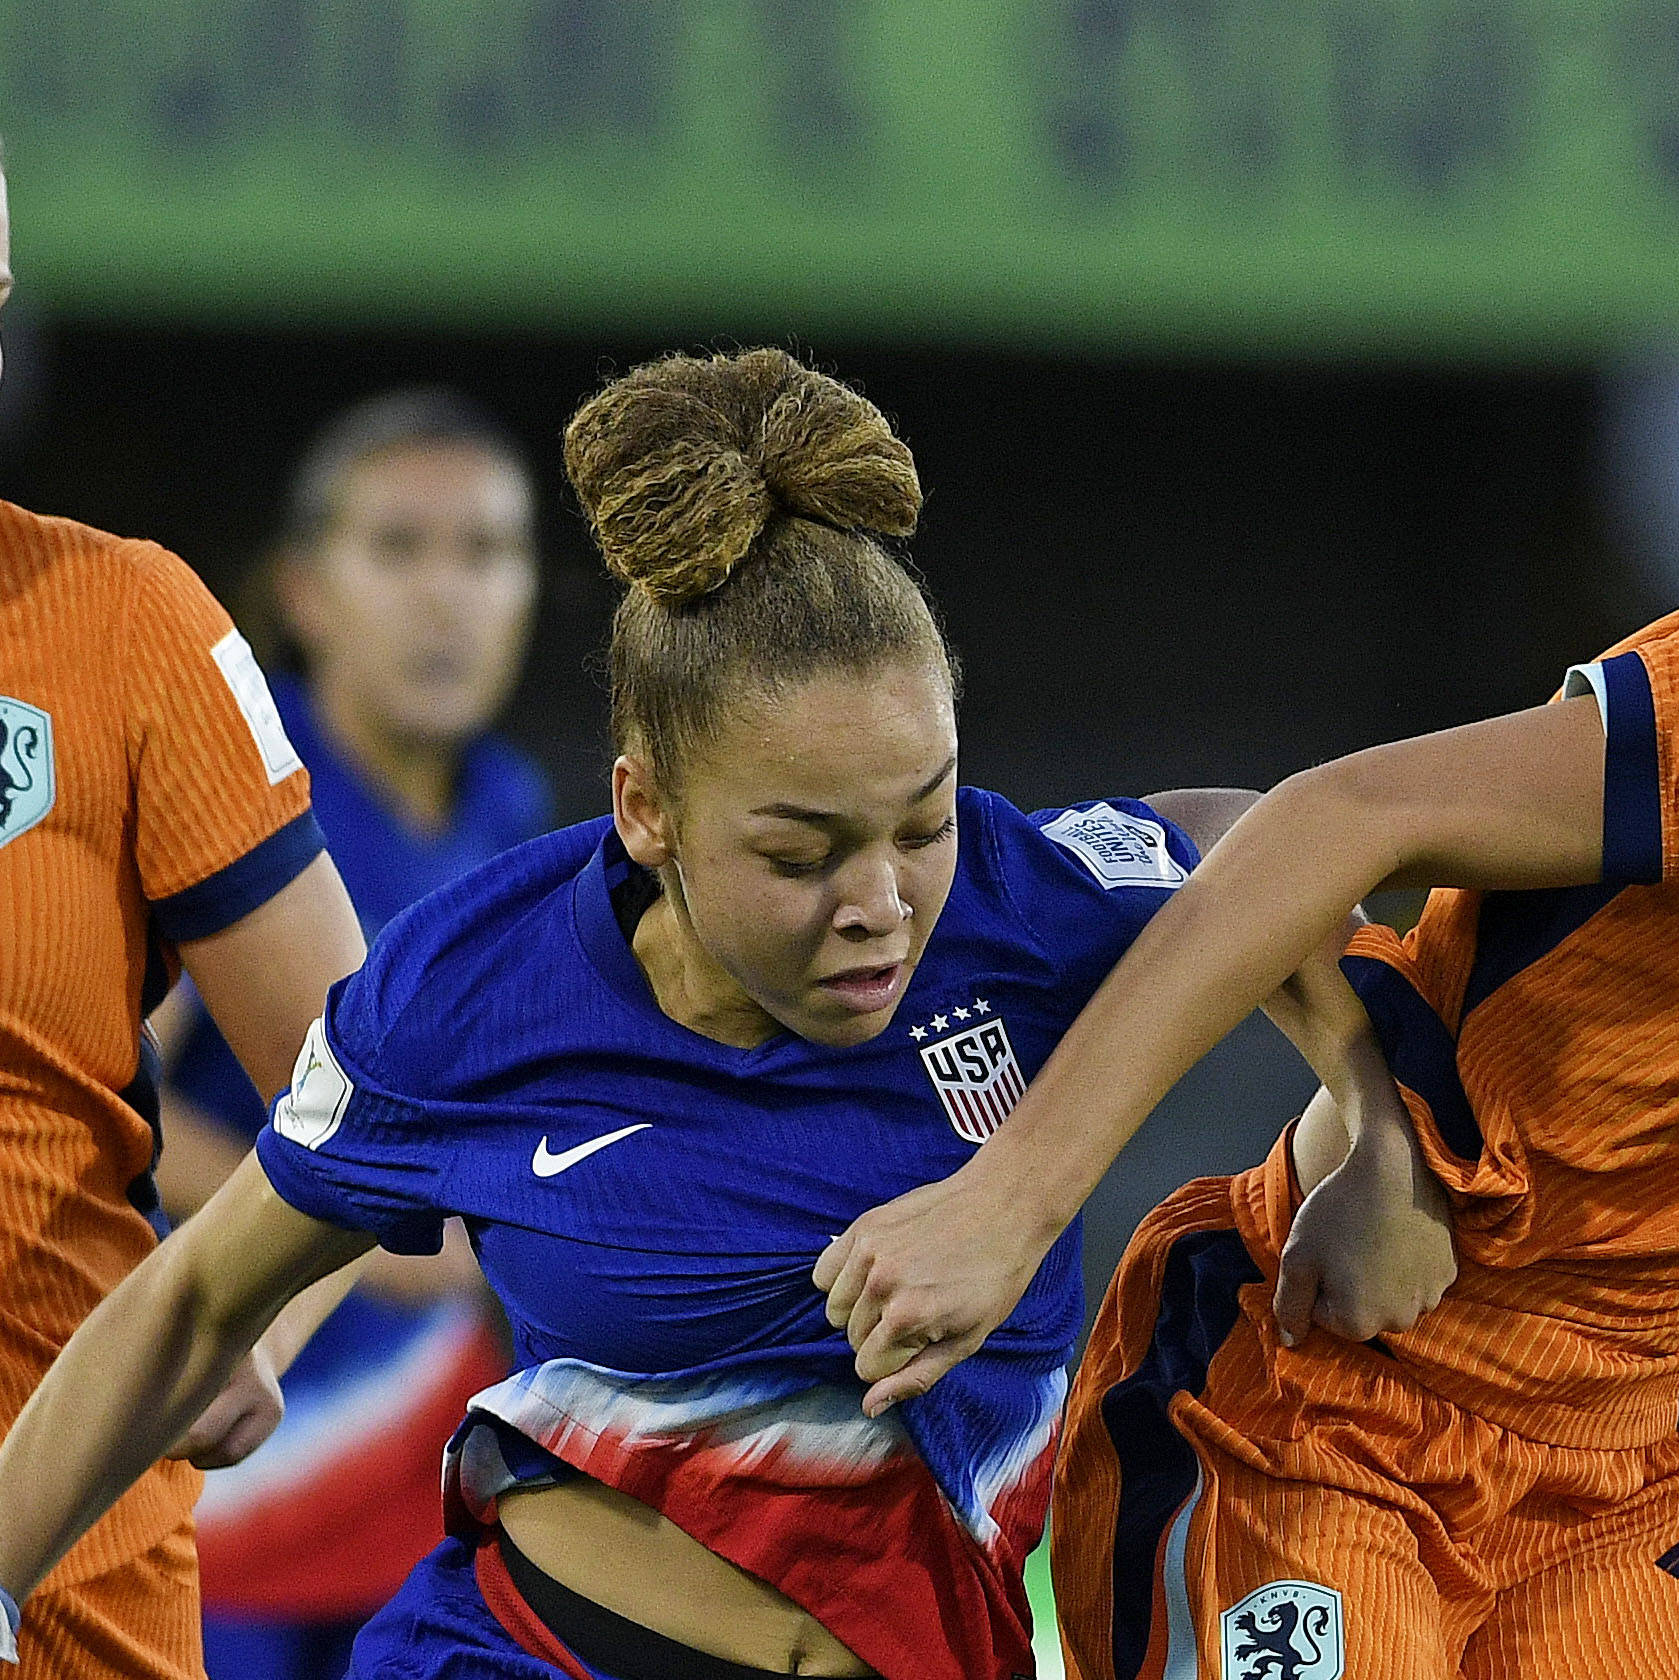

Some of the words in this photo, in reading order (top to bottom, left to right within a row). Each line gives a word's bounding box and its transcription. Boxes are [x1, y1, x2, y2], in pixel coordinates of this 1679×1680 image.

[1061, 826, 1118, 864] FOOTBALL
[1074, 819, 1135, 863] UNITES
[927, 1025, 1008, 1084] USA
[1260, 1590, 1299, 1604] KNVB
